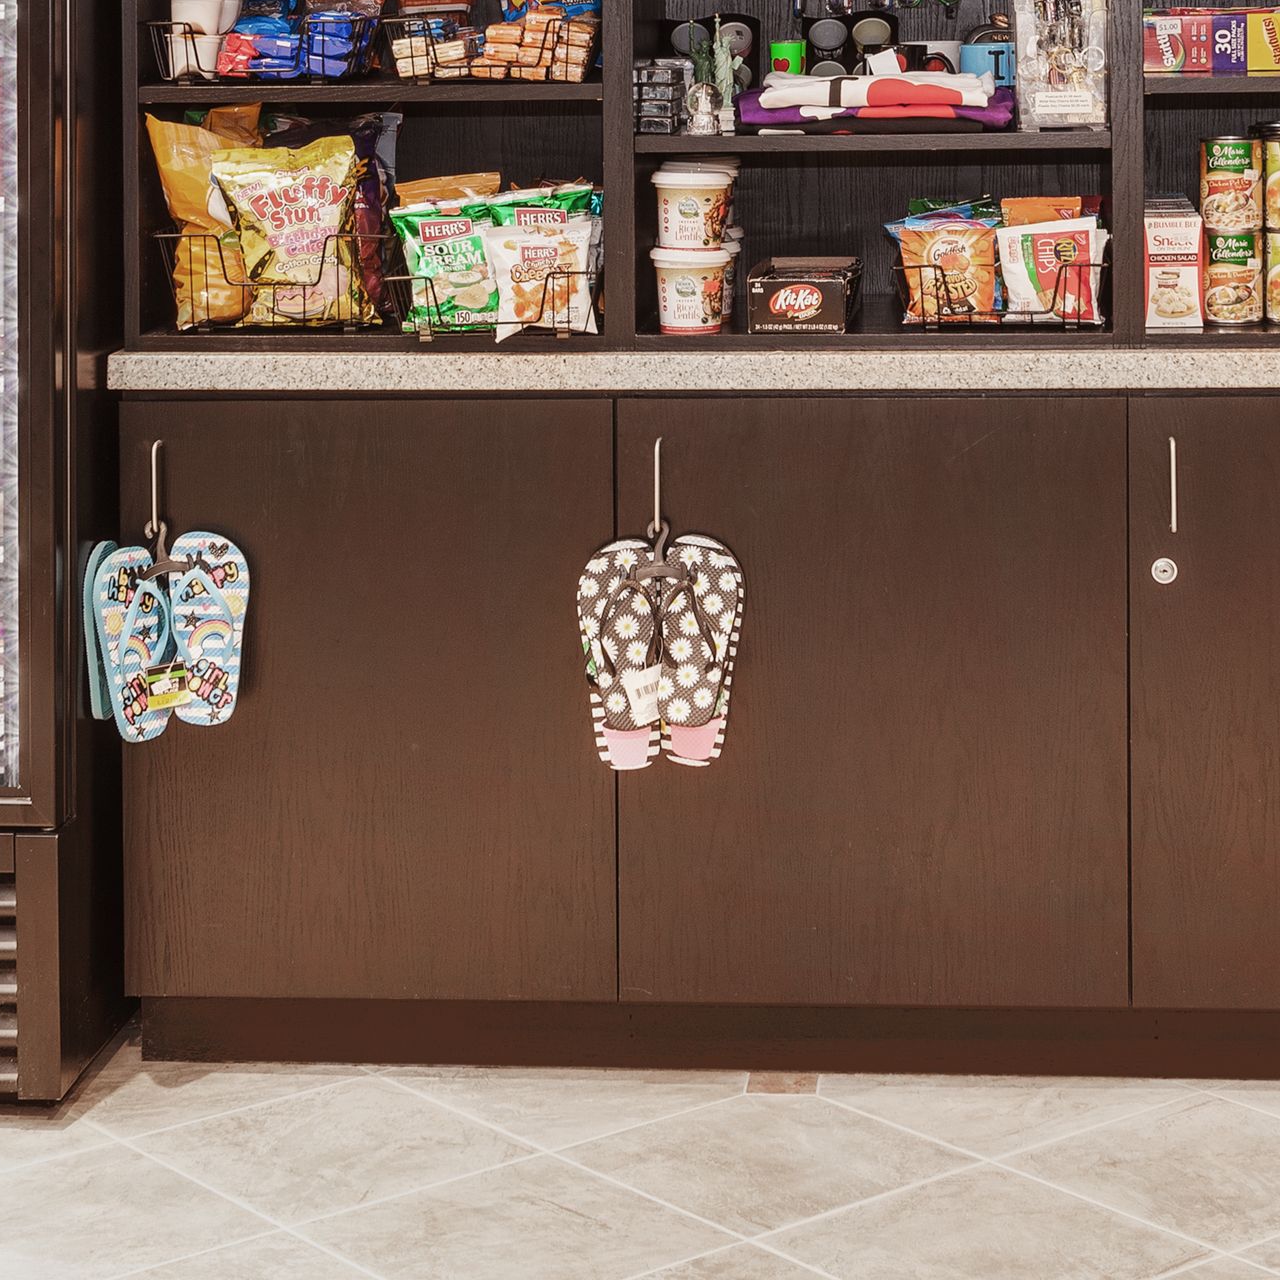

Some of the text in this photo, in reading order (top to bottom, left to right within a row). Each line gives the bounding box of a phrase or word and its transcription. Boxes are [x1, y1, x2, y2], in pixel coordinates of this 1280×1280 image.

[1158, 23, 1178, 31] $1.00
[1215, 30, 1232, 54] 30
[1221, 146, 1245, 157] Marie
[1209, 156, 1250, 168] Callender's
[249, 176, 349, 220] Fluffy
[521, 211, 562, 225] HERR'S
[424, 222, 466, 238] HERR'S
[679, 225, 695, 233] Rice
[285, 240, 325, 257] Cake
[424, 240, 474, 257] SOUR
[1225, 238, 1248, 248] Marie
[421, 252, 482, 266] CREAM
[524, 248, 555, 258] HERR'S
[933, 246, 967, 261] Goldfish
[1038, 238, 1051, 274] CHIPS
[1212, 248, 1253, 259] Callender's
[276, 255, 338, 273] Cotton Candy
[676, 304, 692, 312] Rice
[456, 313, 471, 323] 150
